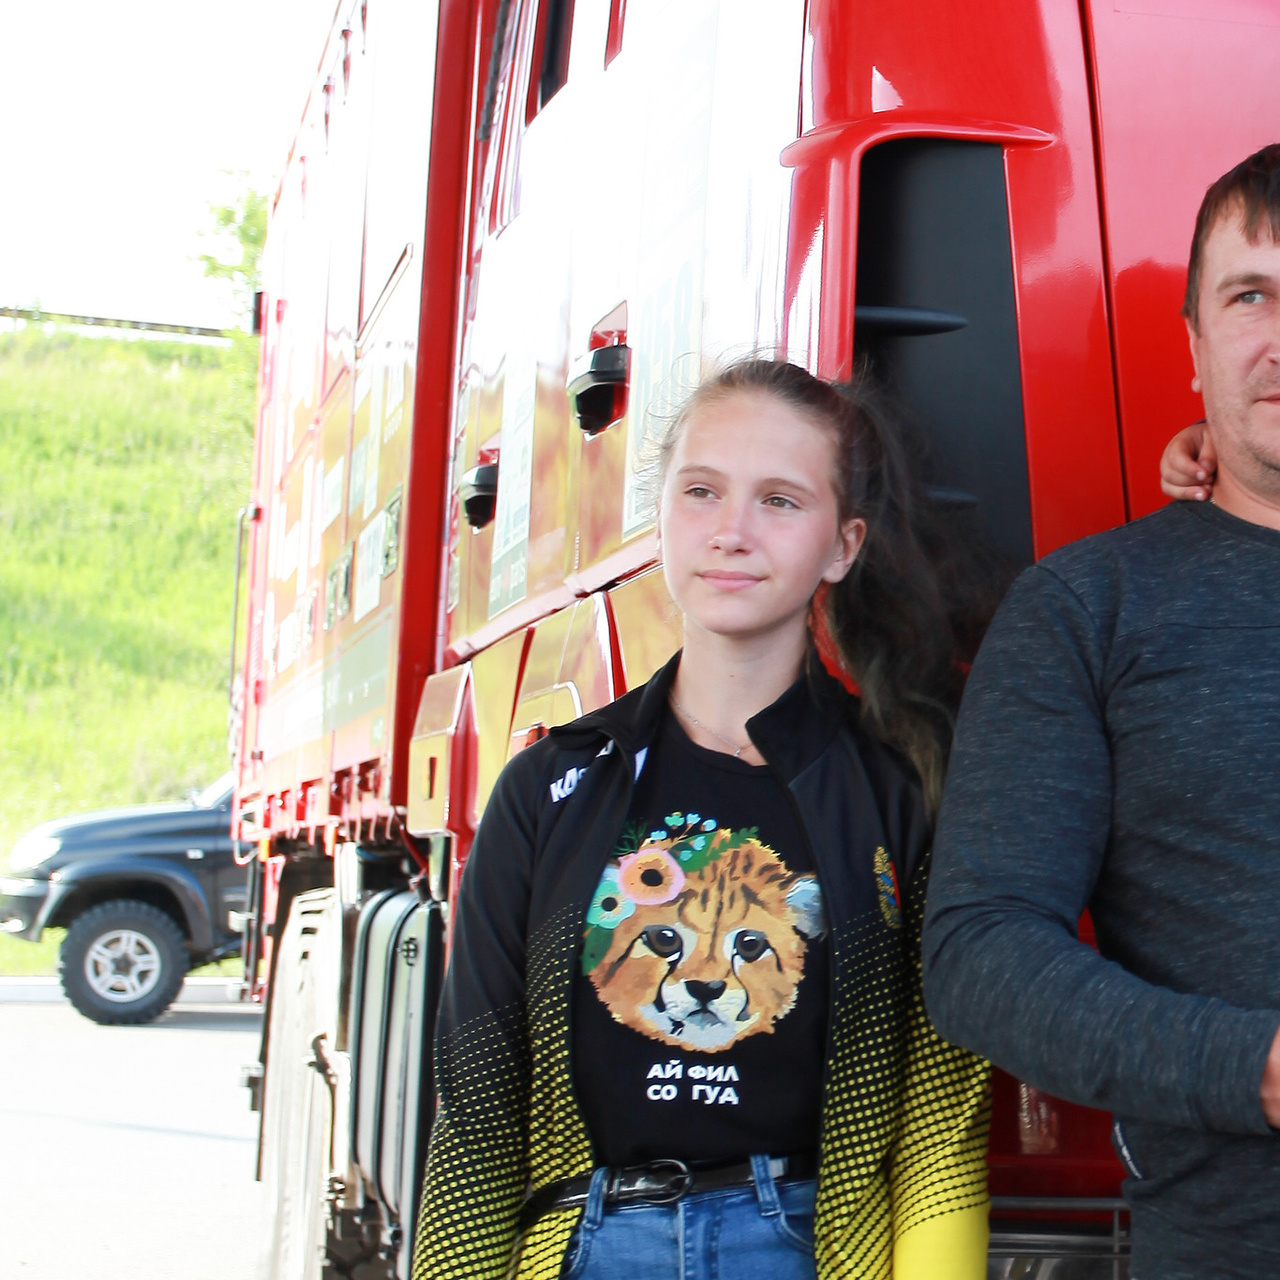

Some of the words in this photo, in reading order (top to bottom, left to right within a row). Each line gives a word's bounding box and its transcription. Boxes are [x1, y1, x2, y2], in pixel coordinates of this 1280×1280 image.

[646, 1059, 683, 1080] АЙ
[687, 1064, 740, 1082] ФИЛ
[646, 1084, 678, 1101] СО
[692, 1084, 740, 1106] ГУД
